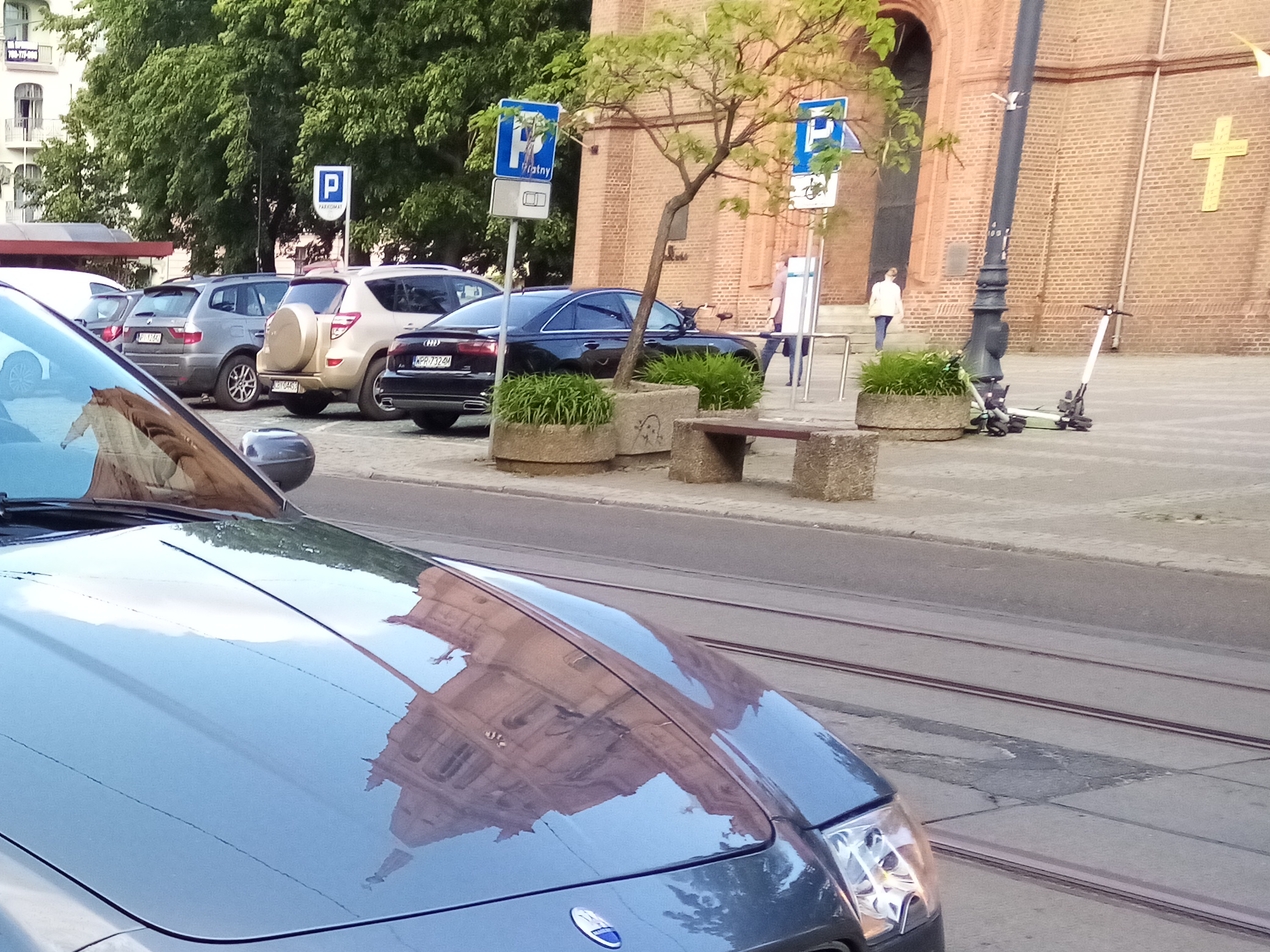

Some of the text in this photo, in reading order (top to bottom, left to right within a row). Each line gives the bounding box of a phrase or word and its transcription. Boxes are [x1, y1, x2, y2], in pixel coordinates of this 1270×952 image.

[509, 110, 545, 168] P
[804, 107, 834, 152] P
[324, 173, 339, 199] P
